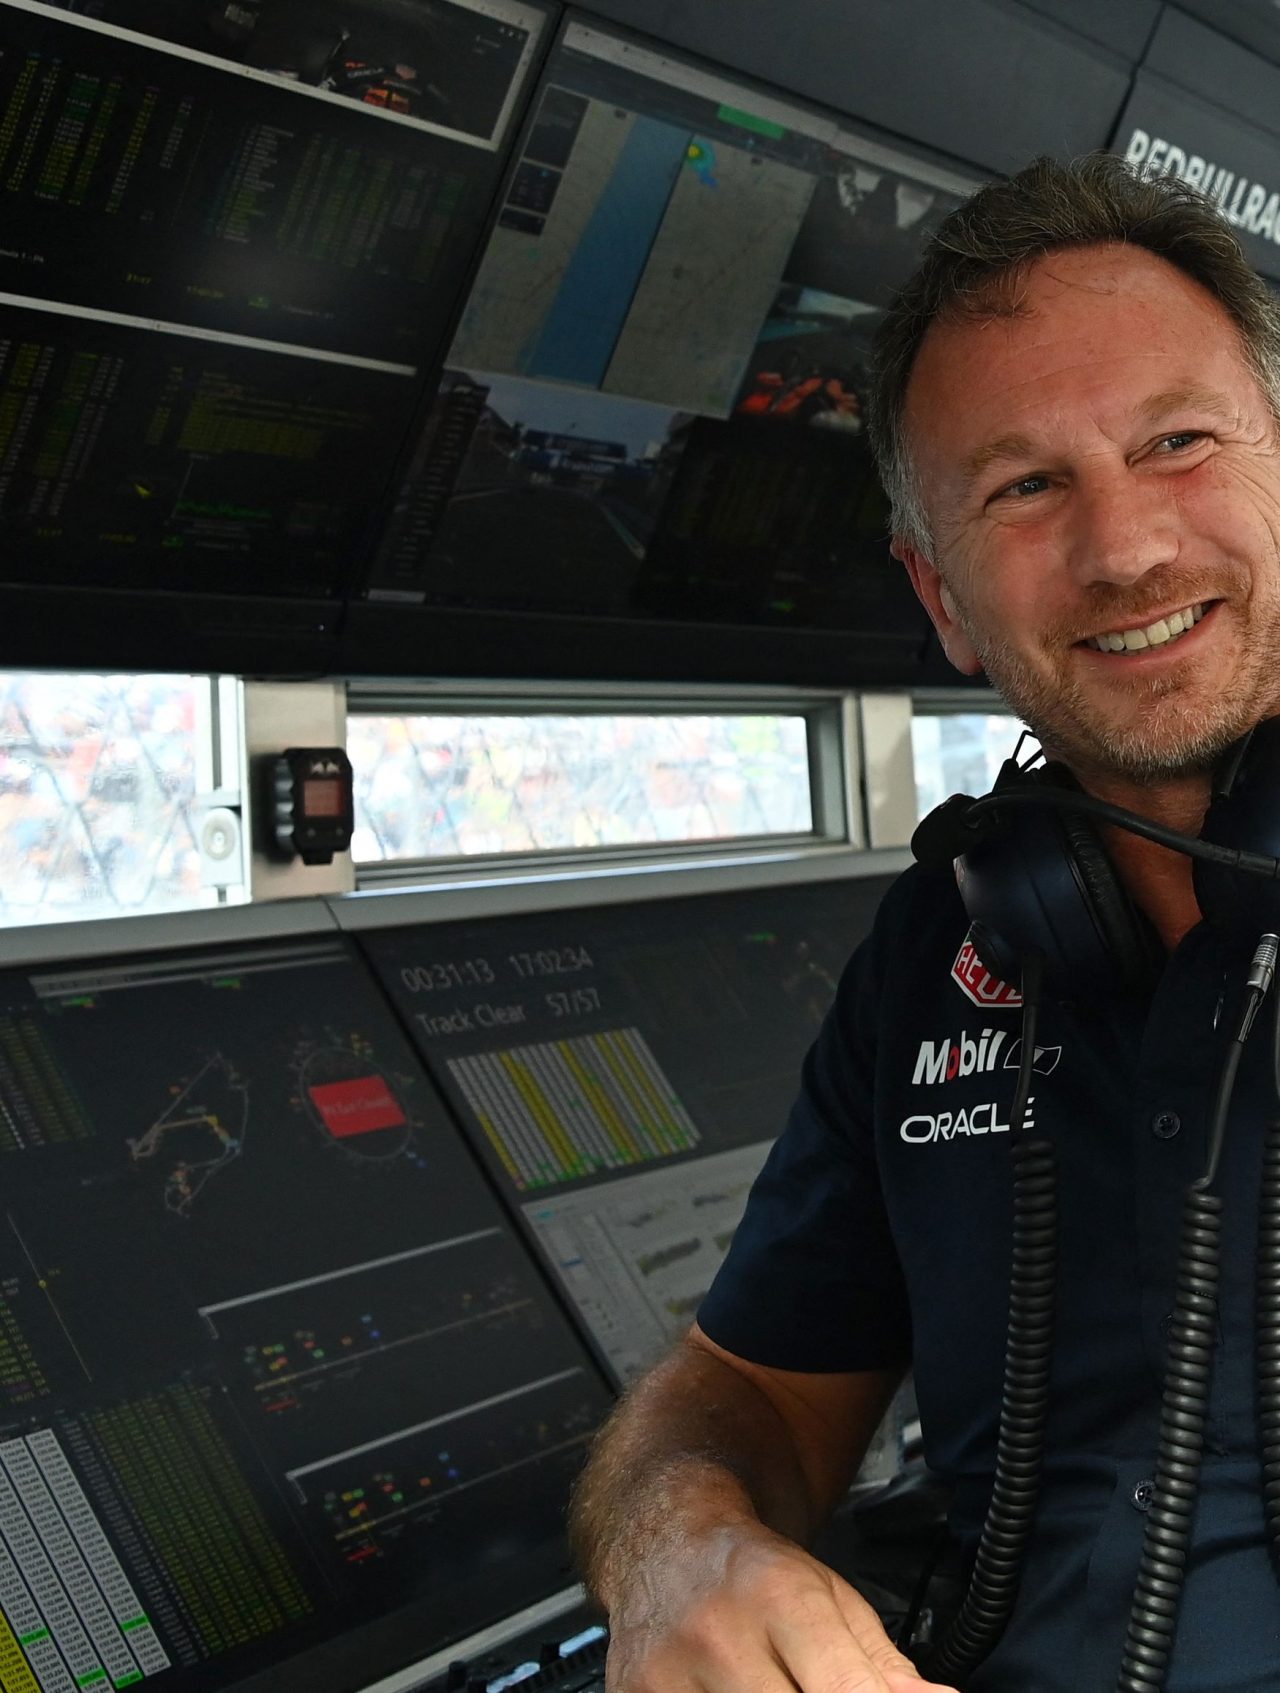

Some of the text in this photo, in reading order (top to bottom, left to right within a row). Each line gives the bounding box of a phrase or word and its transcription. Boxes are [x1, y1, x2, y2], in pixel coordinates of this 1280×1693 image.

[415, 1007, 475, 1037] Track
[473, 1003, 527, 1028] Clear
[911, 1028, 1008, 1085] Mobil
[900, 1097, 1036, 1143] ORACLE
